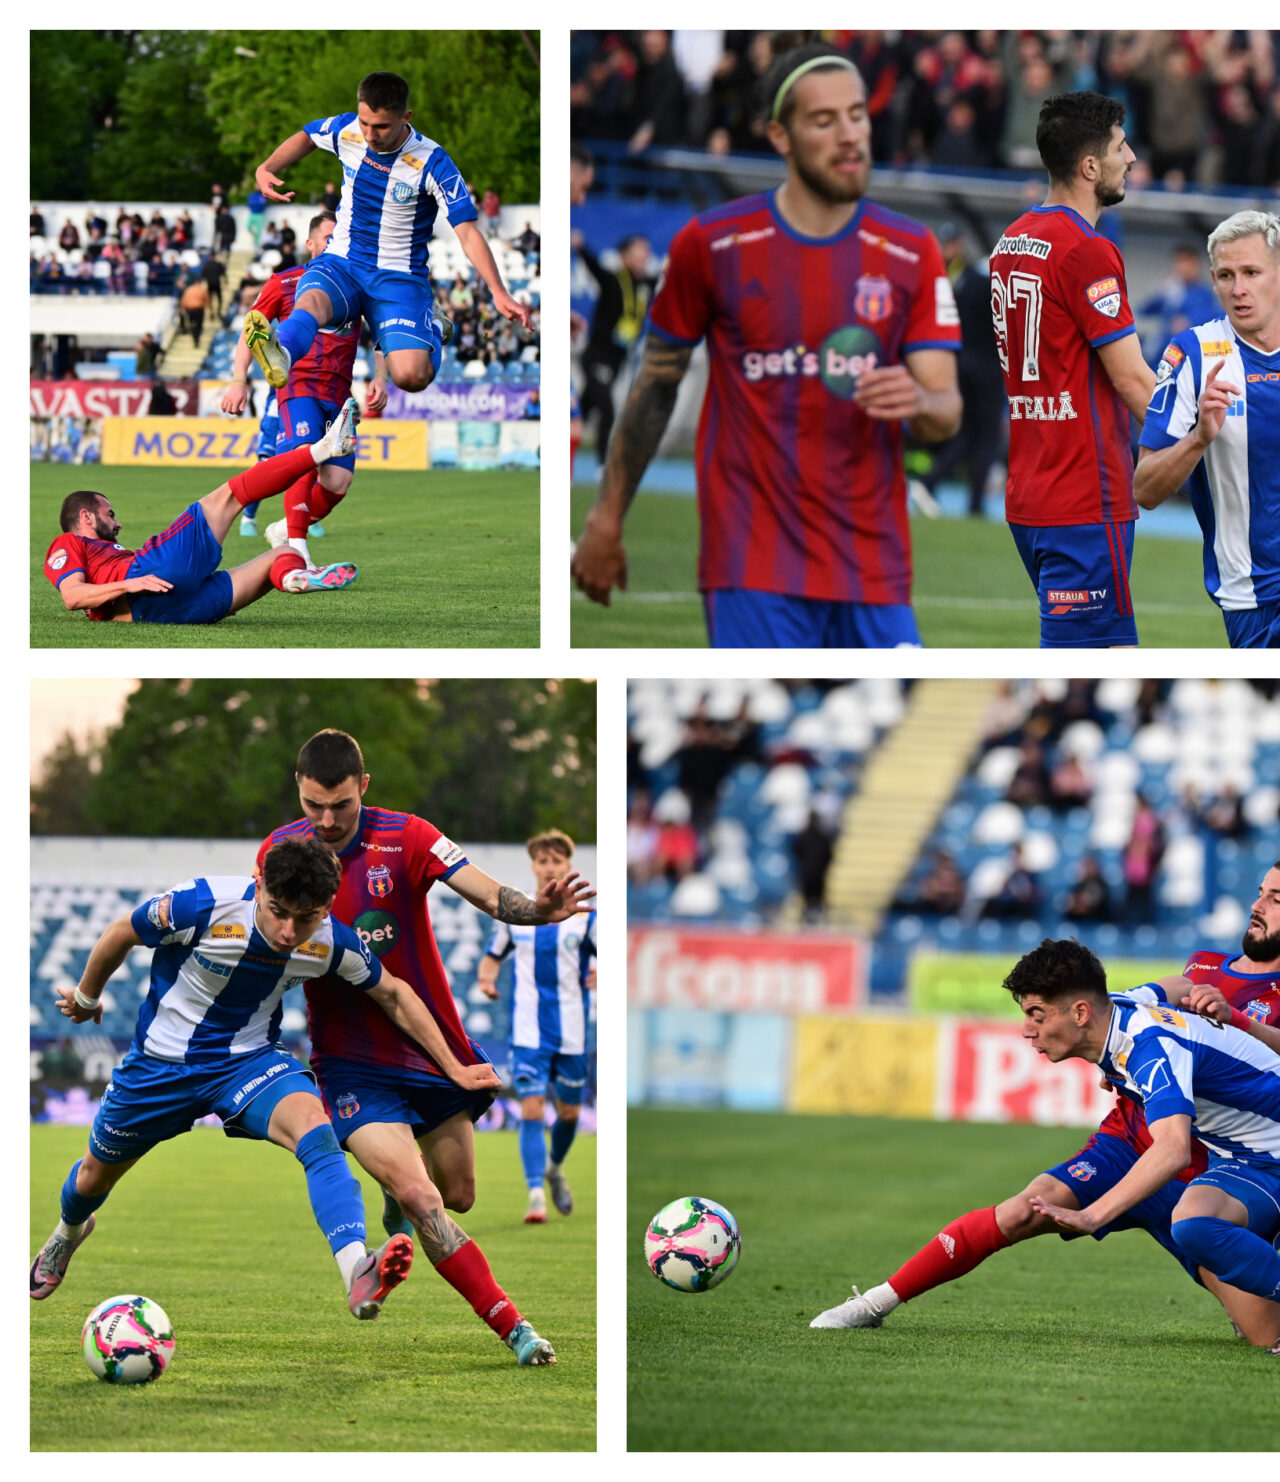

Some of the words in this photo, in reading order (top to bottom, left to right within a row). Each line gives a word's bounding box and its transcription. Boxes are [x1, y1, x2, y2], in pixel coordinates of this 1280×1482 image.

[1050, 592, 1084, 601] STEAUA
[1090, 589, 1107, 600] TV
[356, 923, 394, 944] bet
[265, 1062, 290, 1078] SPORTS
